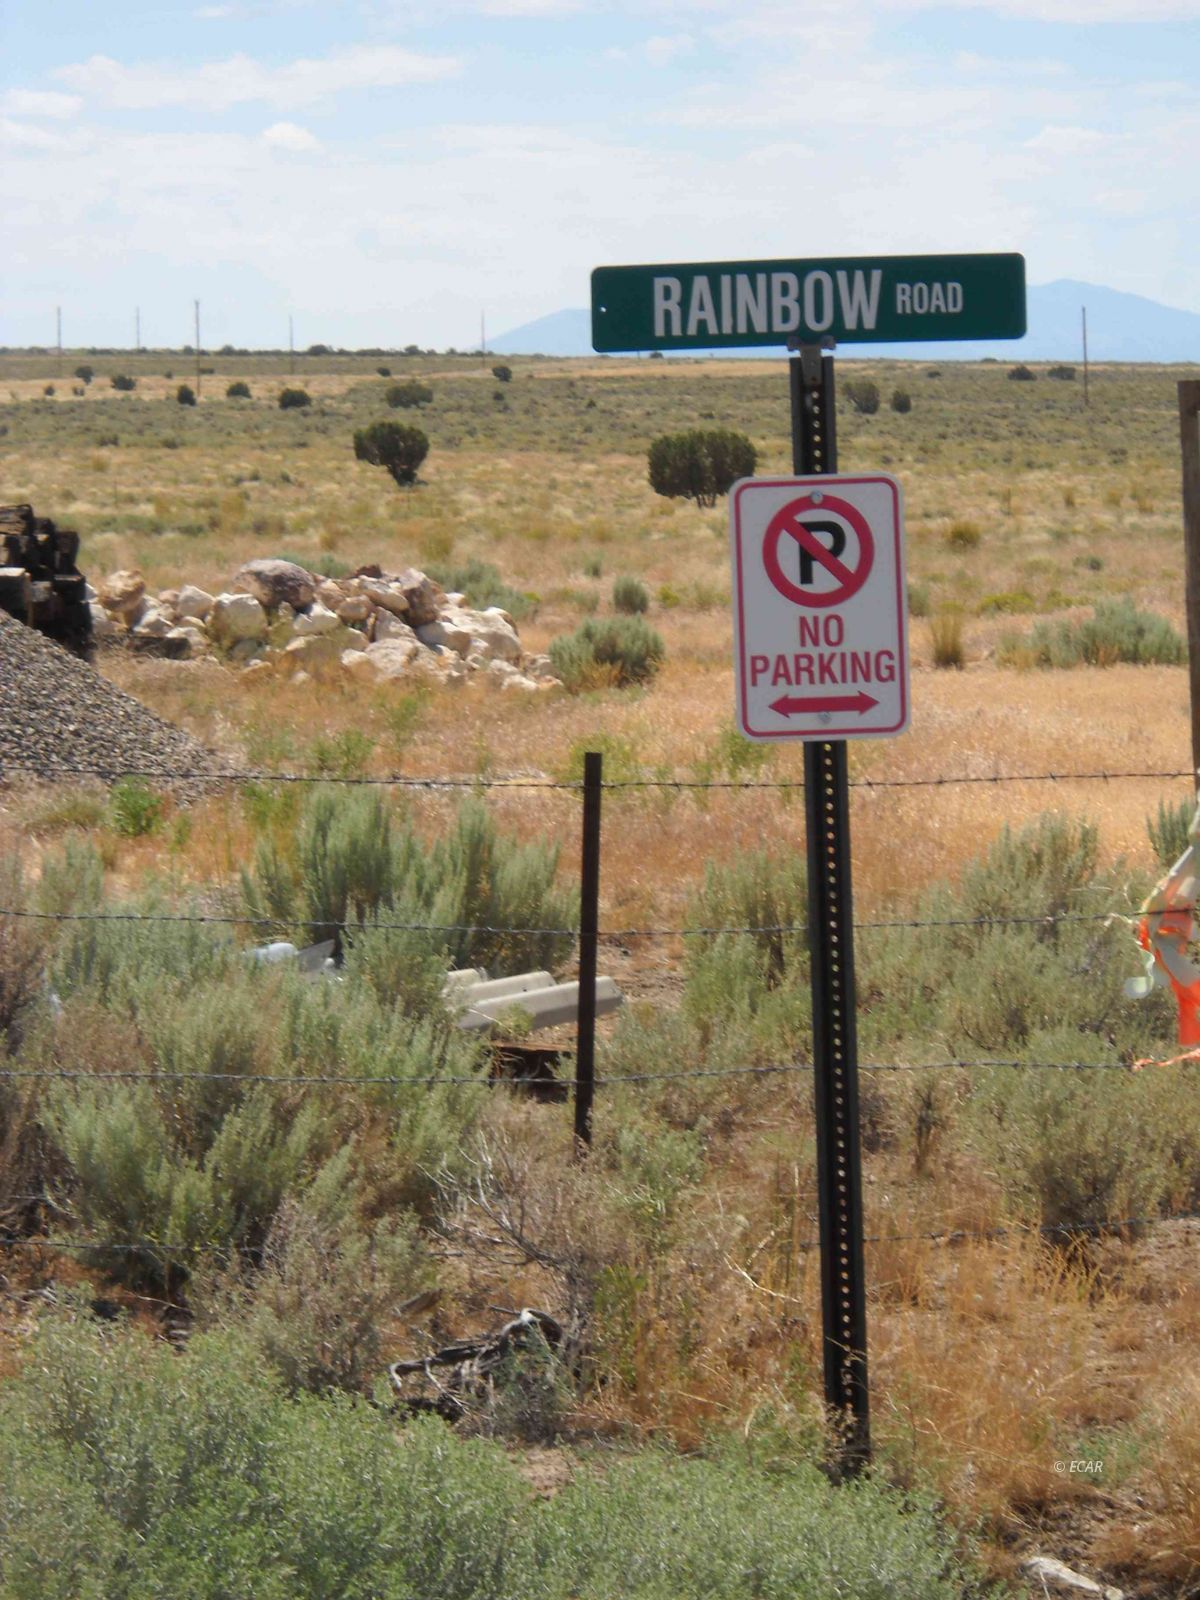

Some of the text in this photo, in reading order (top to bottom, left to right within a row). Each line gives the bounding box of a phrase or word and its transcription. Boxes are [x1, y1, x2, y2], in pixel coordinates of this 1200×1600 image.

[653, 269, 964, 338] RAINBOW ROAD
[798, 520, 847, 585] P
[798, 613, 845, 648] NO
[750, 649, 896, 687] PARKING
